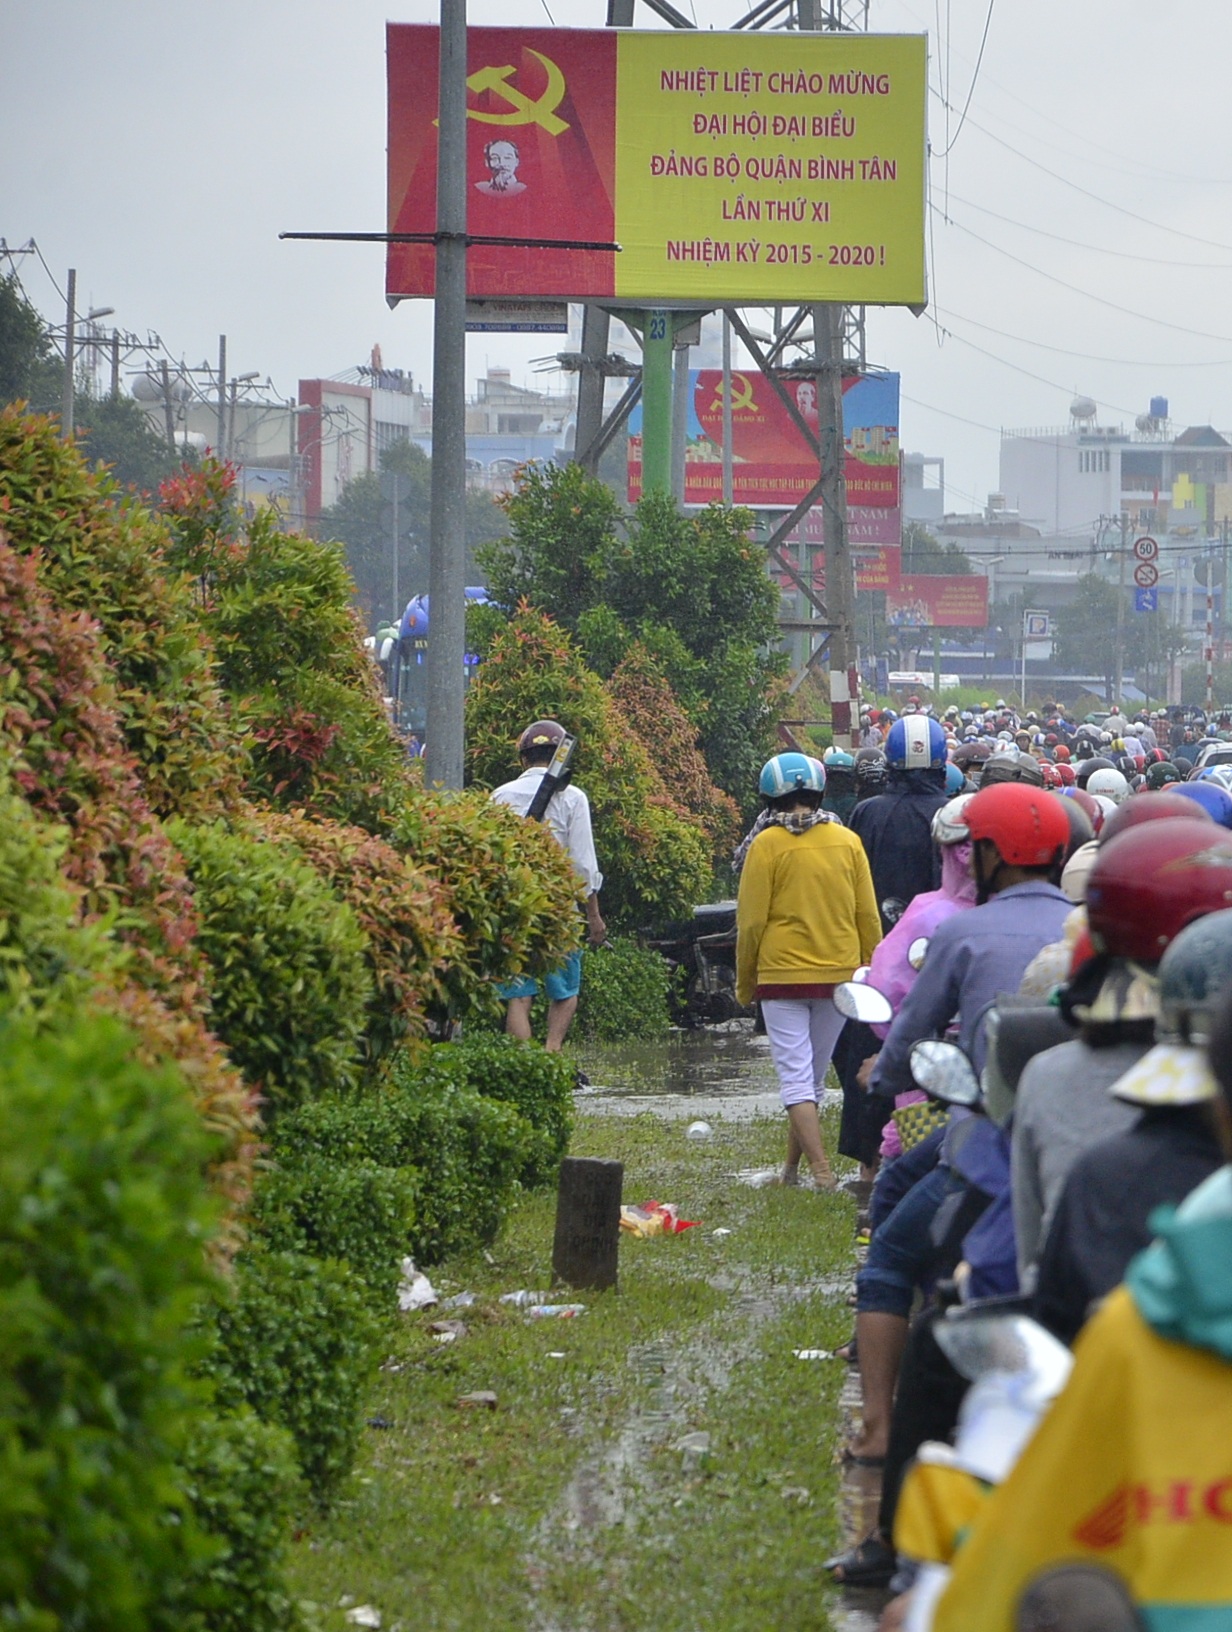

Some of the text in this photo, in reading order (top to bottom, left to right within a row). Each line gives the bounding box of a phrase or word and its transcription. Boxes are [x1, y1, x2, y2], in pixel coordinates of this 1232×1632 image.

[660, 66, 890, 98] NHIỆT LIỆT CHÀO MỪNG
[693, 109, 856, 142] ĐẠI HỘI ĐẠI BIỂU
[650, 149, 897, 184] ĐẢNG BỘ QUẬN BÌNH TÂN
[722, 193, 830, 222] LẦN THỨ XI
[666, 237, 731, 267] NHIỆM
[736, 238, 761, 263] KỲ
[766, 243, 812, 265] 2015
[828, 245, 875, 266] 2020
[650, 319, 666, 340] 23
[1140, 543, 1153, 555] 50
